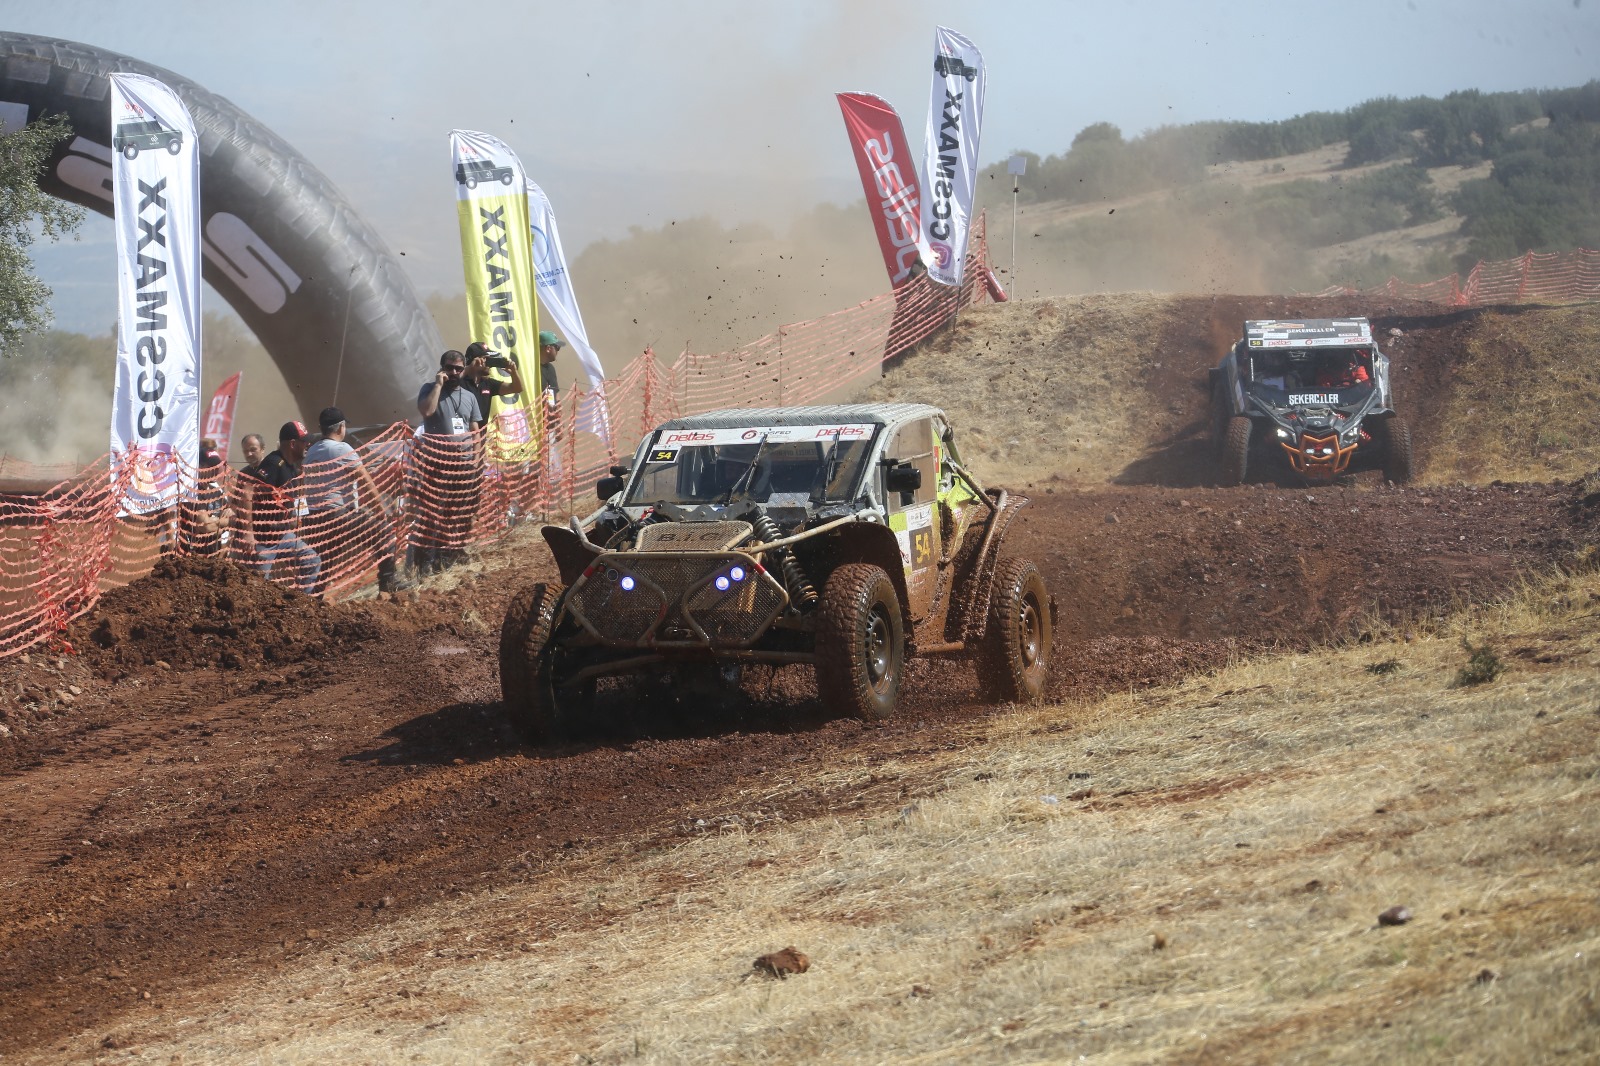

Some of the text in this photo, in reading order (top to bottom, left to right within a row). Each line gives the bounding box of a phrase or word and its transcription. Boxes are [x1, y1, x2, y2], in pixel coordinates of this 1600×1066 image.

[815, 425, 866, 438] petlas
[666, 432, 715, 445] petlas
[656, 452, 673, 460] 54
[915, 532, 931, 564] 54
